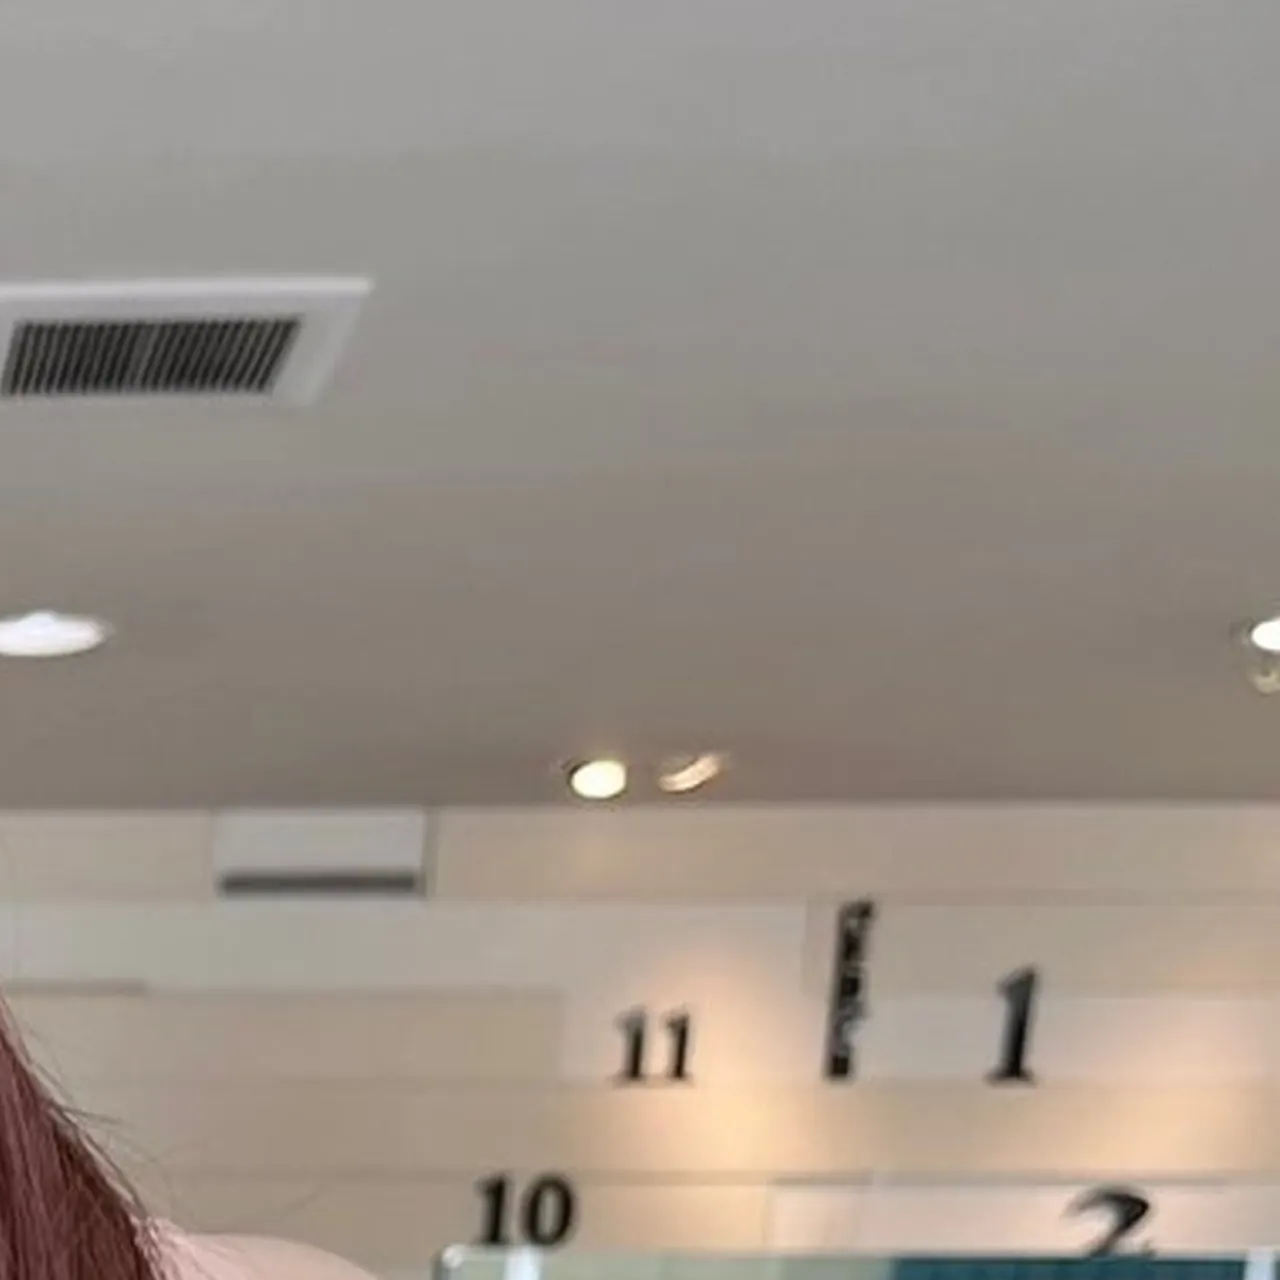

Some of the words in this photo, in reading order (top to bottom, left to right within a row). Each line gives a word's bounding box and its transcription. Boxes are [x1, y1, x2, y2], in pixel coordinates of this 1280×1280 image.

[612, 1007, 693, 1084] 11
[986, 968, 1040, 1084] 1
[474, 1174, 578, 1247] 10
